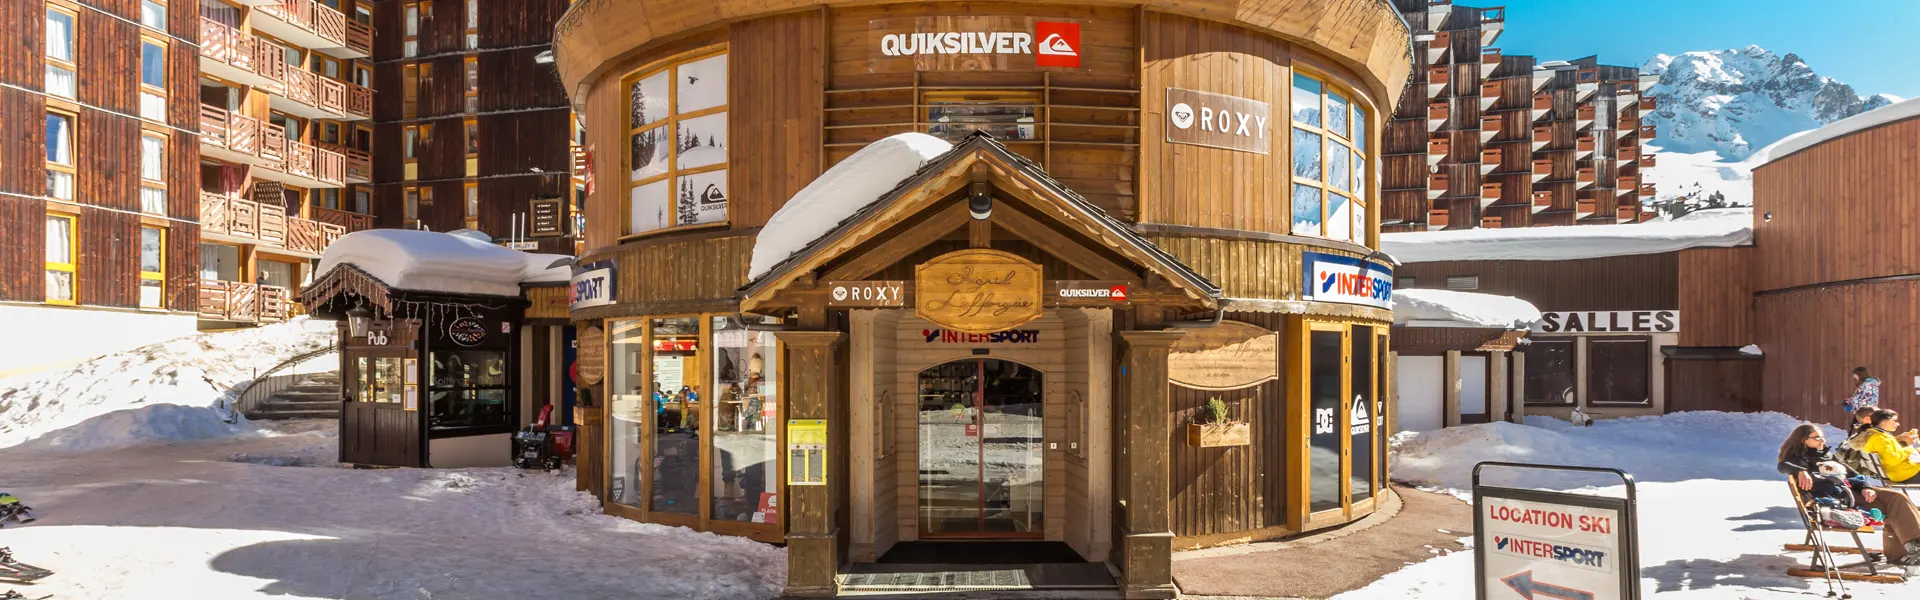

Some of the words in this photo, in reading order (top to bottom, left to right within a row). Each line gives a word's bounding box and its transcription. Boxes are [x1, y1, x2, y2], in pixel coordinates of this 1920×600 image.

[881, 32, 1031, 56] QUIKSILVER
[1201, 106, 1267, 139] ROXY
[946, 265, 1016, 294] Ingrid
[1337, 272, 1392, 302] INTERSPORT
[851, 286, 900, 301] ROXY
[1059, 288, 1111, 297] QUIKSILVER
[1541, 310, 1674, 333] SALLES
[368, 331, 388, 346] Pub
[942, 329, 1040, 343] INTERSPORT
[1316, 408, 1333, 435] DC
[1490, 505, 1573, 529] LOCATION
[1579, 515, 1611, 534] SKI
[1510, 538, 1604, 568] INTERSPORT
